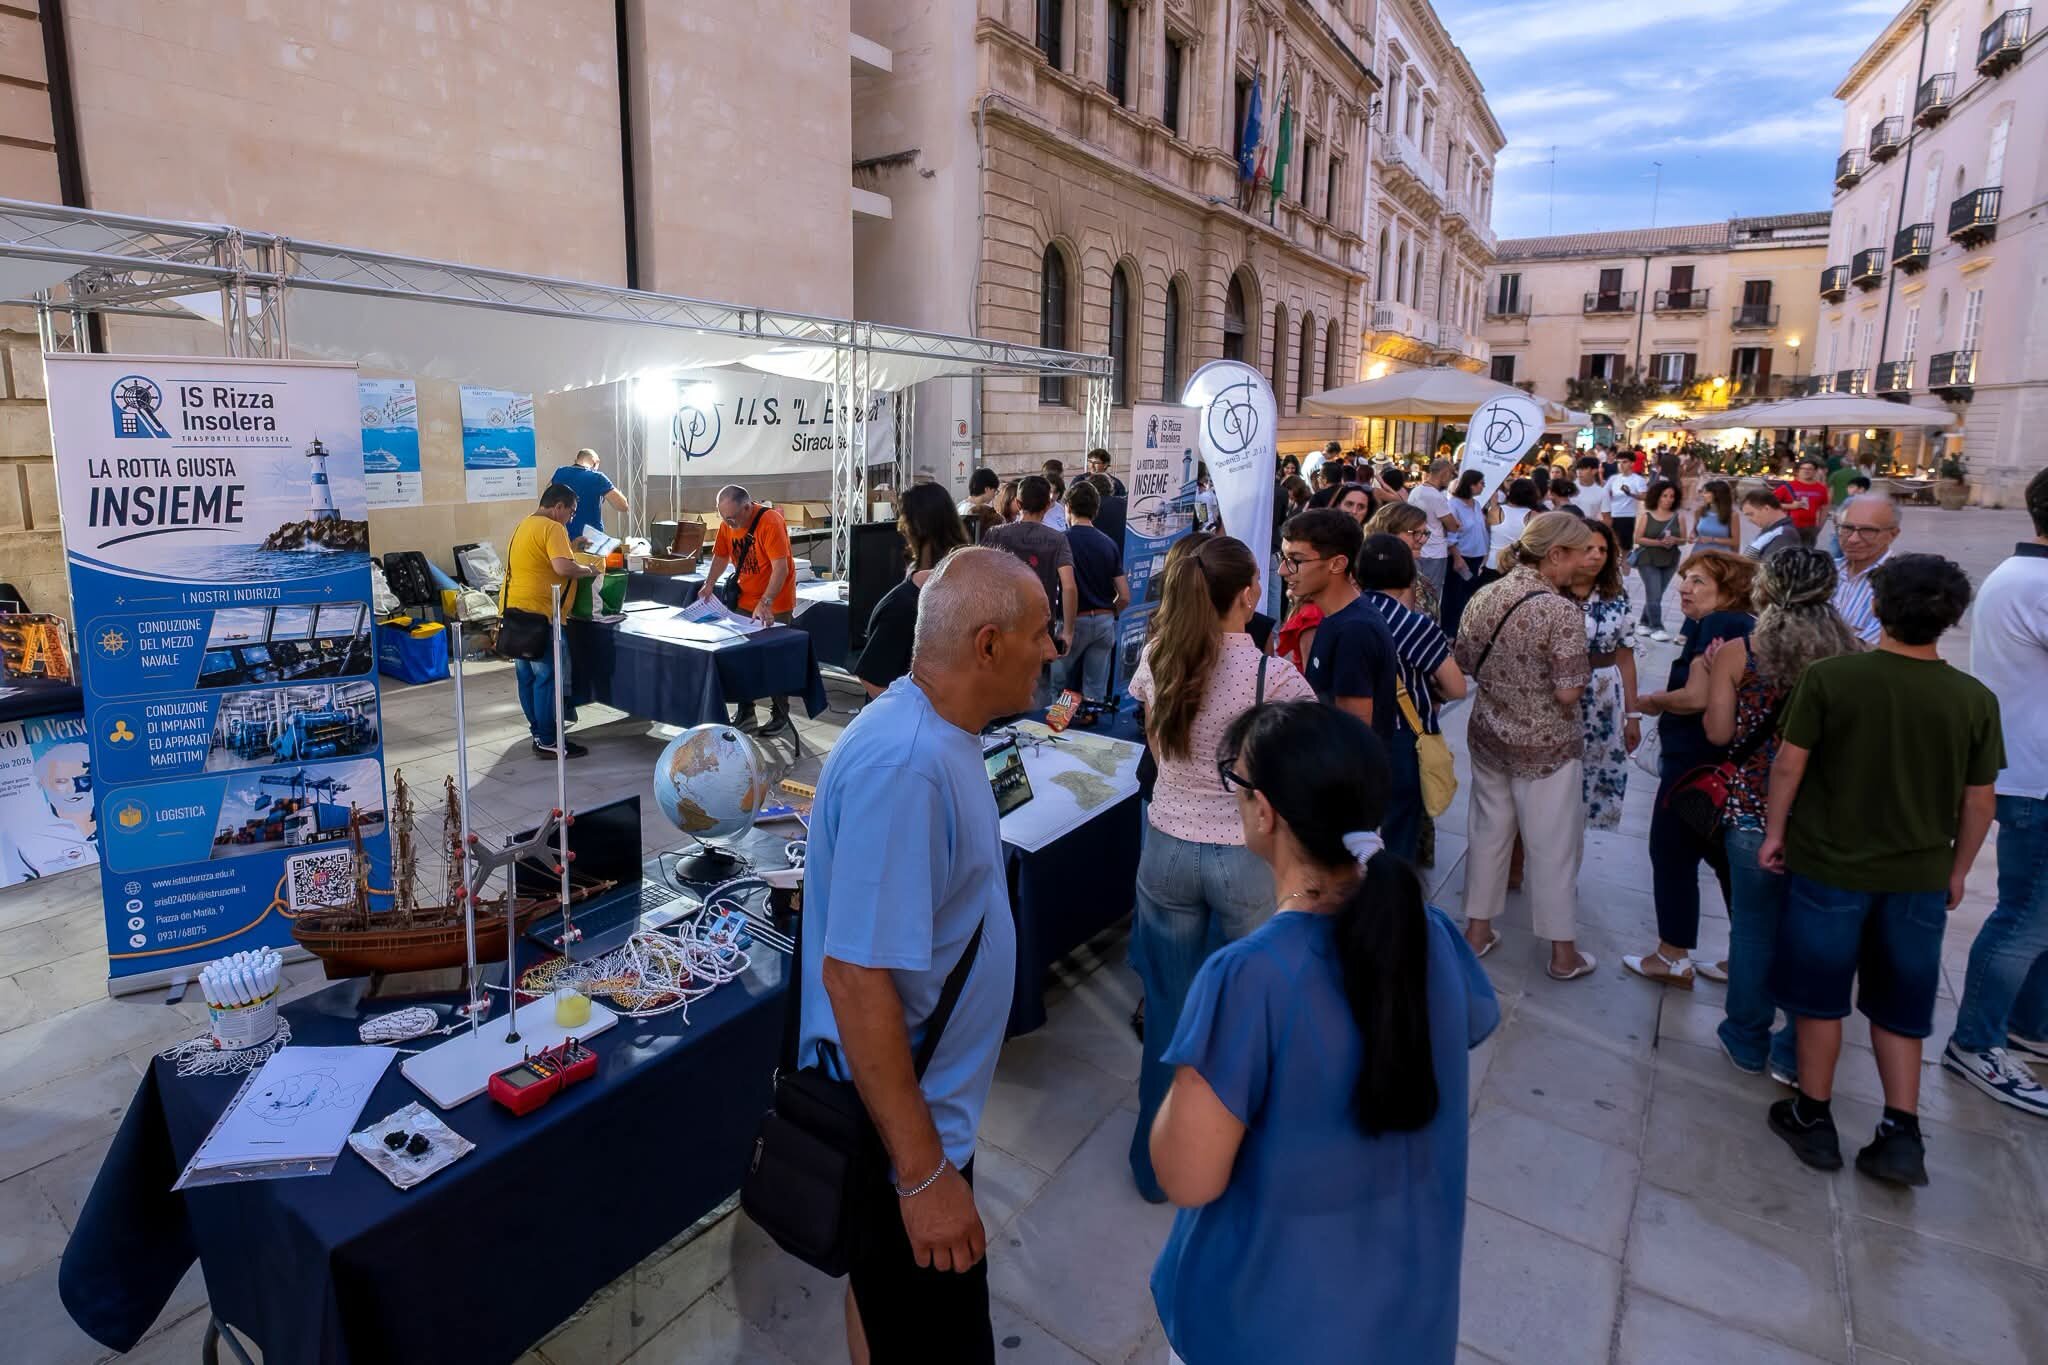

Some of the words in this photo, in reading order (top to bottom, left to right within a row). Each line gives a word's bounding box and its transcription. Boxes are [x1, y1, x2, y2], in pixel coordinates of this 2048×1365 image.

[181, 387, 204, 408] IS
[212, 387, 274, 409] Rizza
[182, 410, 276, 431] Insolera
[88, 458, 112, 478] LA
[117, 458, 172, 478] ROTTA
[177, 458, 237, 477] GIUSTA
[1134, 474, 1169, 496] INSIEME
[88, 485, 245, 527] INSIEME
[182, 592, 186, 604] I
[190, 590, 230, 604] NOSTRI
[234, 587, 281, 601] INDIRIZZI
[138, 619, 203, 634] CONDUZIONE
[140, 638, 160, 651] DEL
[162, 635, 194, 649] MEZZO
[141, 653, 180, 668] NAVALE
[146, 701, 209, 718] CONDUZIONE
[20, 723, 43, 745] Lo
[147, 722, 158, 734] DI
[161, 717, 205, 733] IMPIANTI
[149, 738, 162, 751] ED
[165, 733, 211, 749] APPARATI
[12, 757, 32, 768] 2026
[151, 750, 203, 767] MARITTIMI
[155, 805, 206, 822] LOGISTICA
[156, 913, 179, 925] Piazza
[219, 905, 225, 914] 9
[157, 925, 207, 942] 0931/68075
